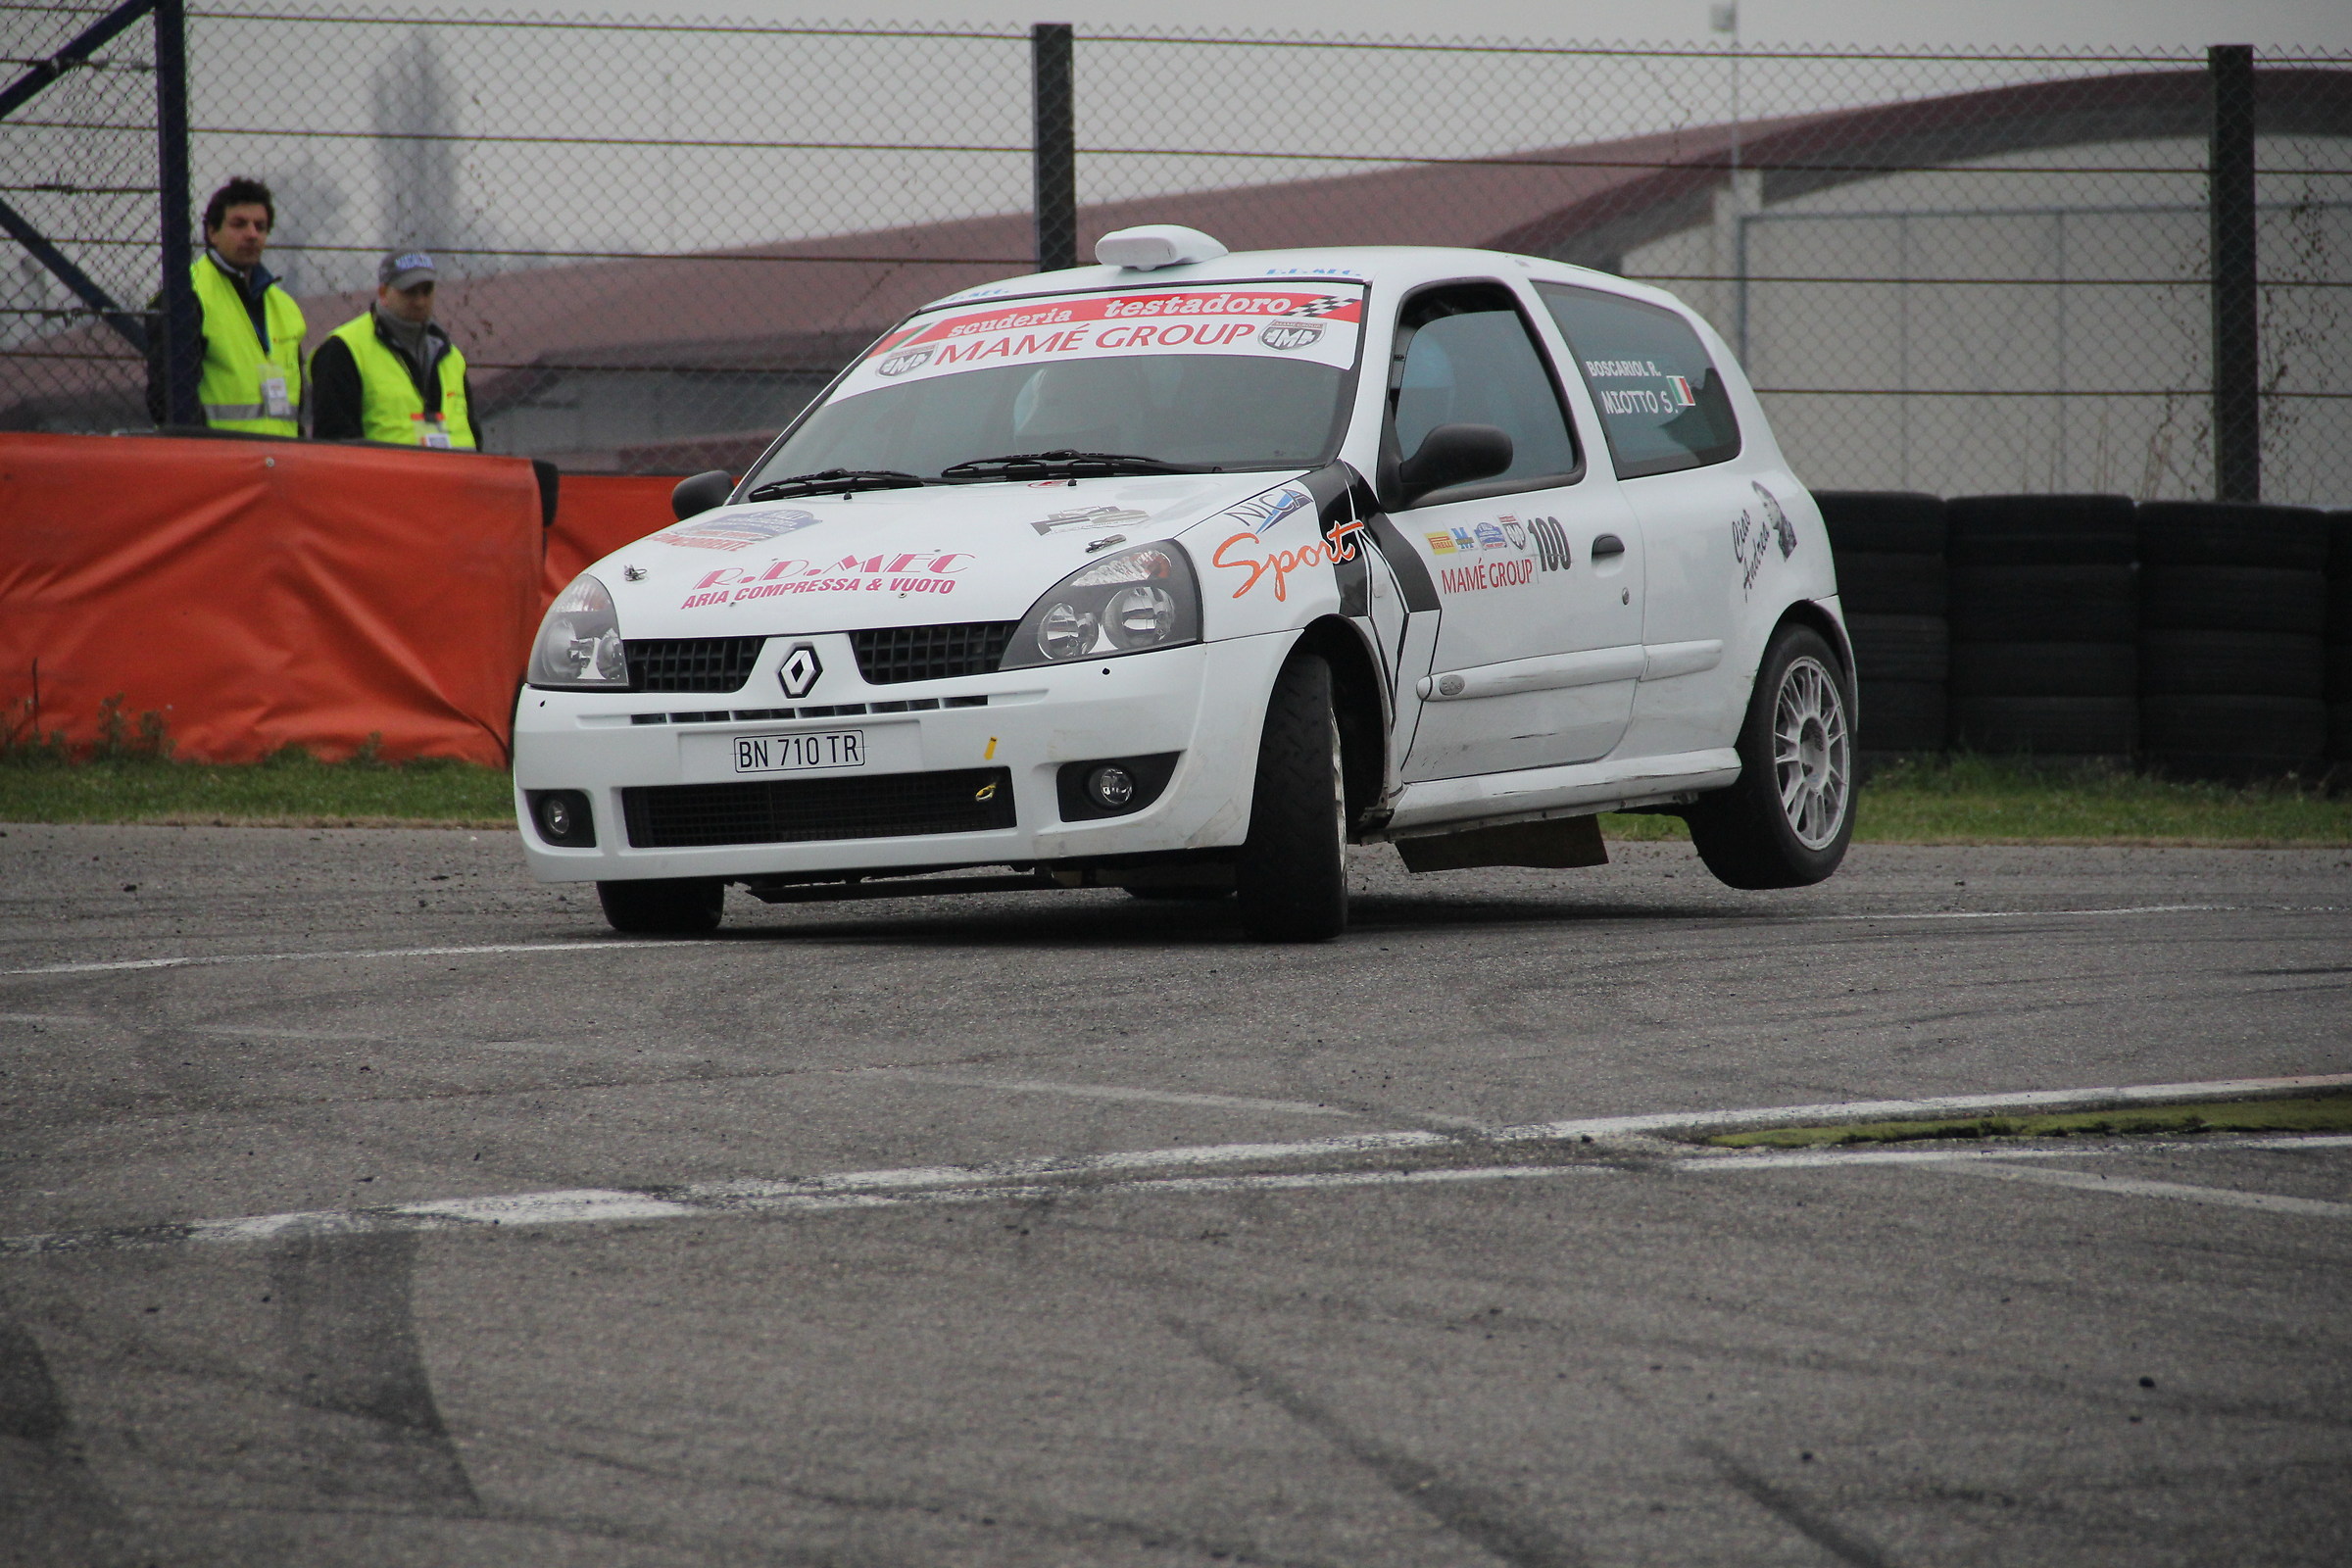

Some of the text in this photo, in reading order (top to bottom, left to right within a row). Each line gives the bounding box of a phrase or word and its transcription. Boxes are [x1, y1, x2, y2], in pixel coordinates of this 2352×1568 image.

[948, 294, 1292, 338] scuderia testadoro
[934, 322, 1256, 367] MAMÉ GROUP
[1586, 360, 1662, 377] BOSCARIOL R.
[1600, 390, 1679, 415] MIOTTO S.
[1224, 488, 1314, 526] NICA
[1212, 519, 1364, 602] Sport
[1428, 535, 1454, 551] PIRELLI
[1527, 515, 1572, 572] 100
[680, 577, 956, 610] ARIA COMPRESSA & VUOTO
[1441, 557, 1533, 595] MAMÉ GROUP
[739, 735, 858, 767] BN 710 TR
